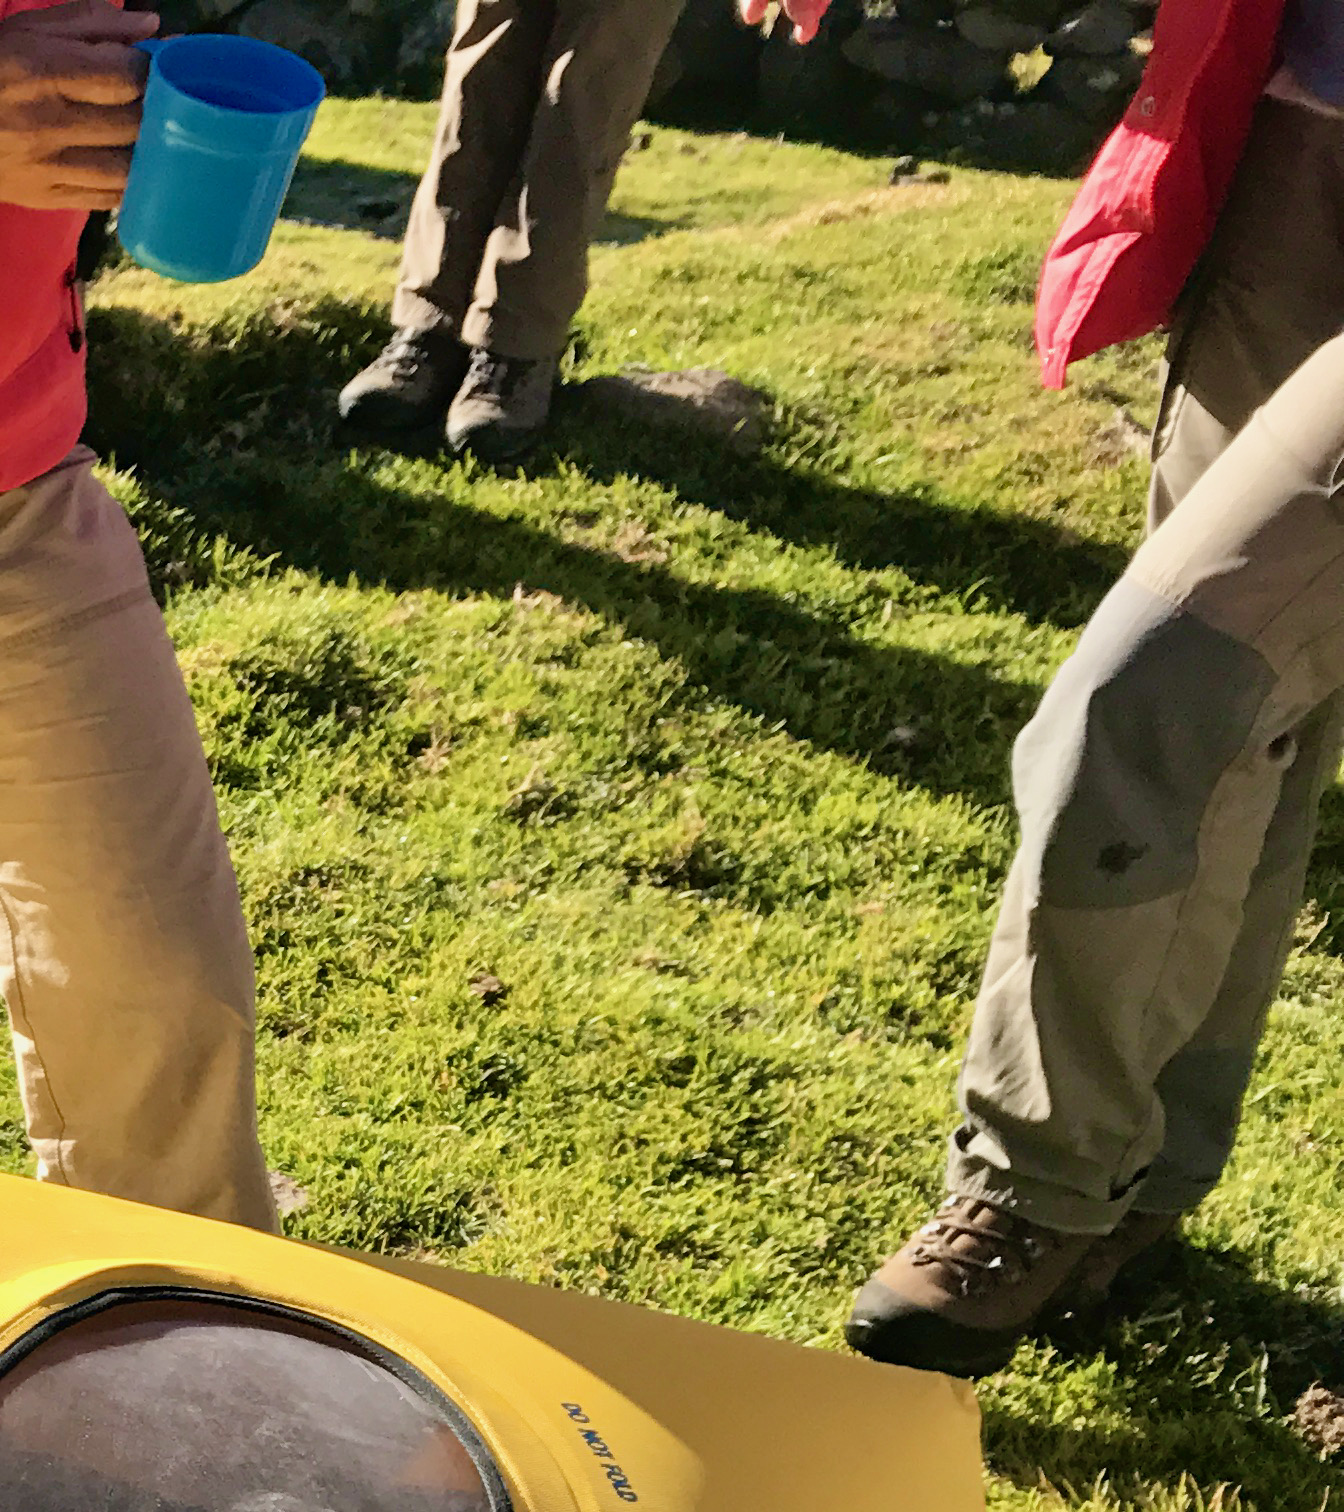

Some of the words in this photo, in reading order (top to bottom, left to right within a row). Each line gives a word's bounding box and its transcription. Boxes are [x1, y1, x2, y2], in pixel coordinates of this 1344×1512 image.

[561, 1403, 590, 1423] DO
[577, 1428, 615, 1460] NOT
[600, 1463, 638, 1502] FOLD
